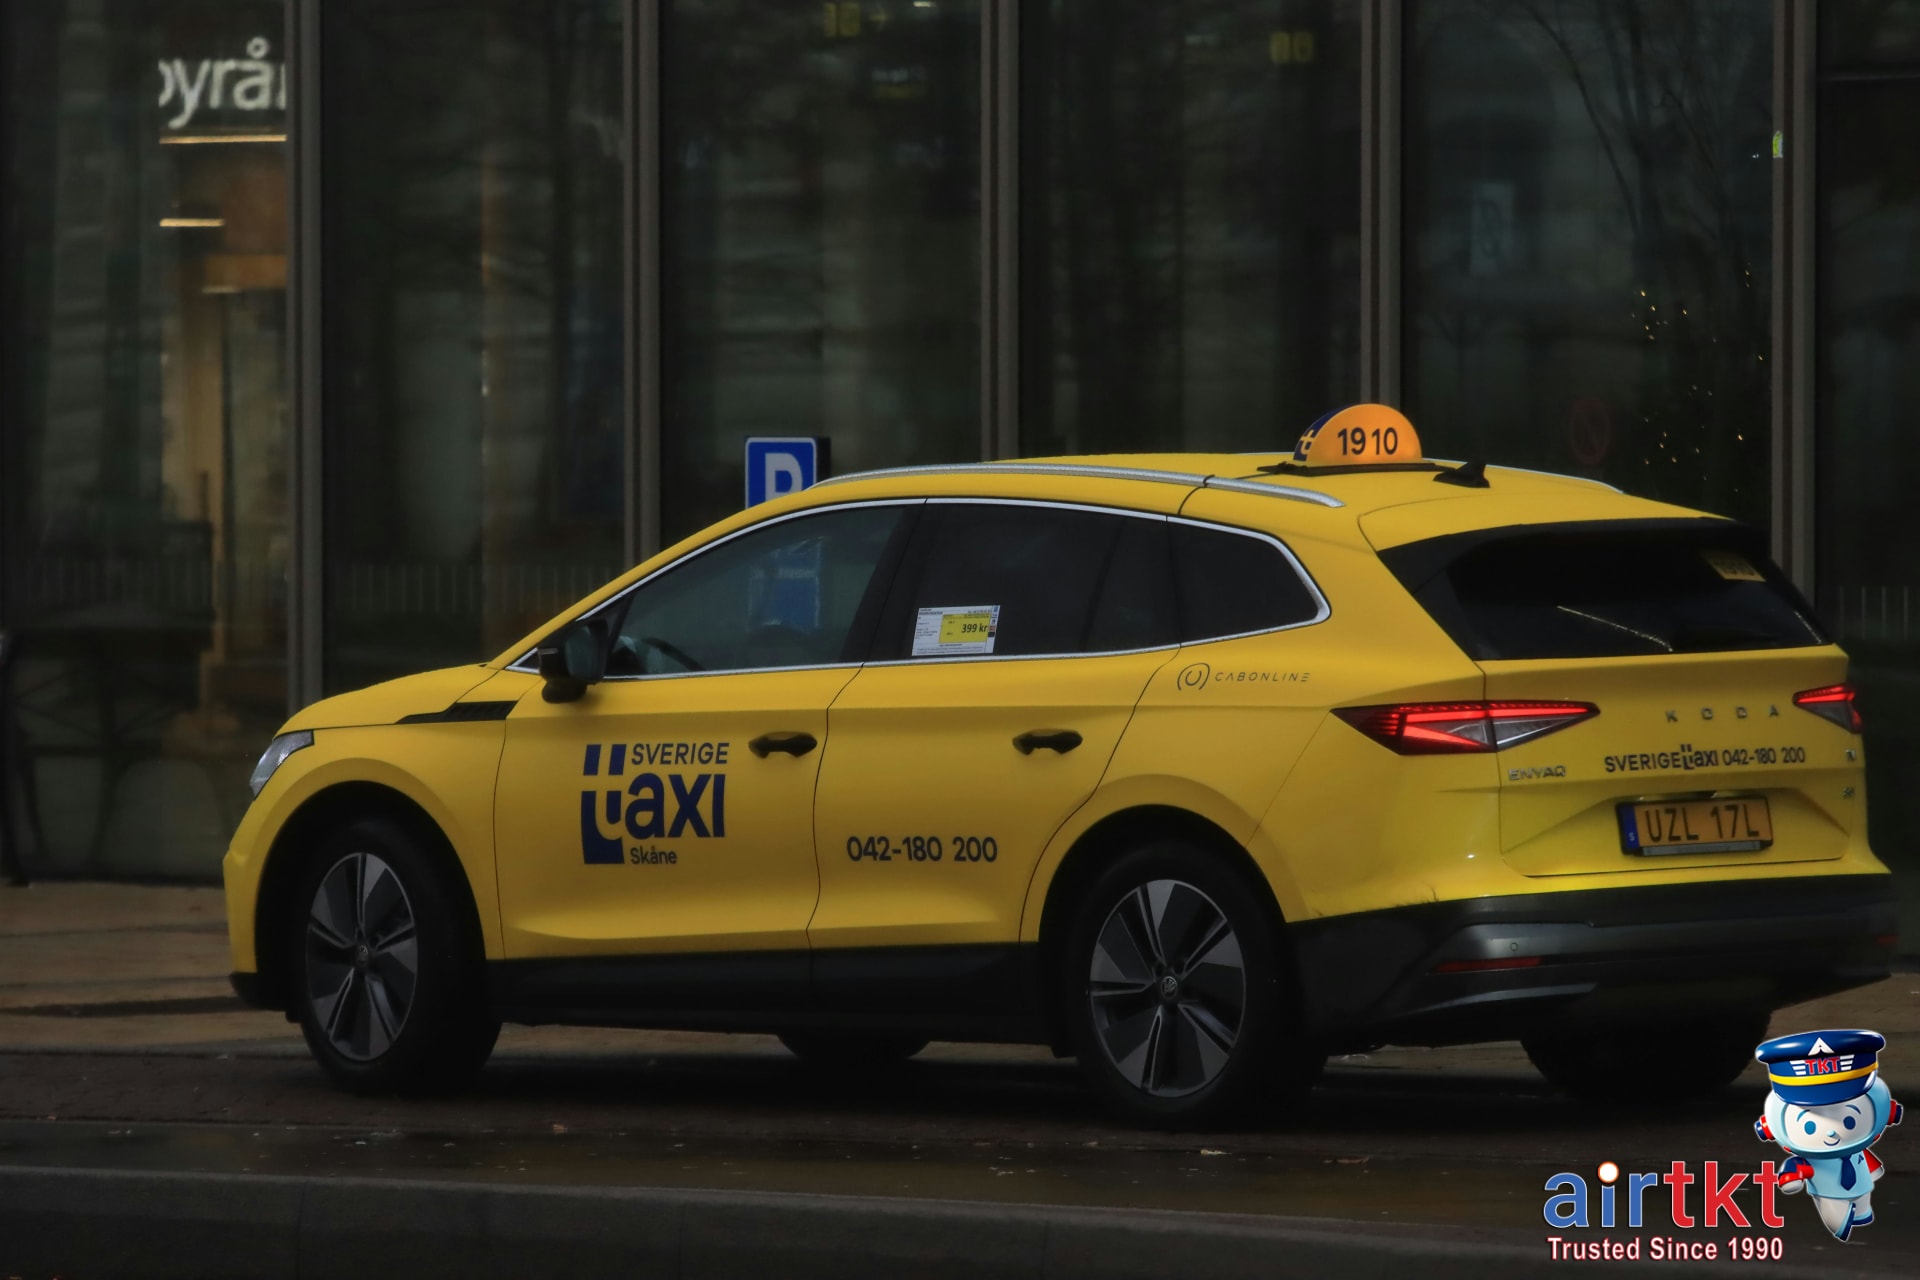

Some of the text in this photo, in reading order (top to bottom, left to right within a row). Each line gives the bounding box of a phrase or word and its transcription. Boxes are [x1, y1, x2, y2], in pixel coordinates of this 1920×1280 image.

[1338, 427, 1398, 455] 1910
[765, 452, 803, 502] P
[961, 623, 988, 633] 399 kr
[1215, 671, 1311, 682] CABONLINE
[631, 742, 729, 765] SVERIGE
[1722, 748, 1777, 766] 042-180
[1781, 747, 1806, 764] 200
[1508, 765, 1566, 781] ENYAQ
[1645, 804, 1759, 842] UZL 17L
[630, 845, 677, 864] Skåne
[846, 836, 998, 862] 042-180 200
